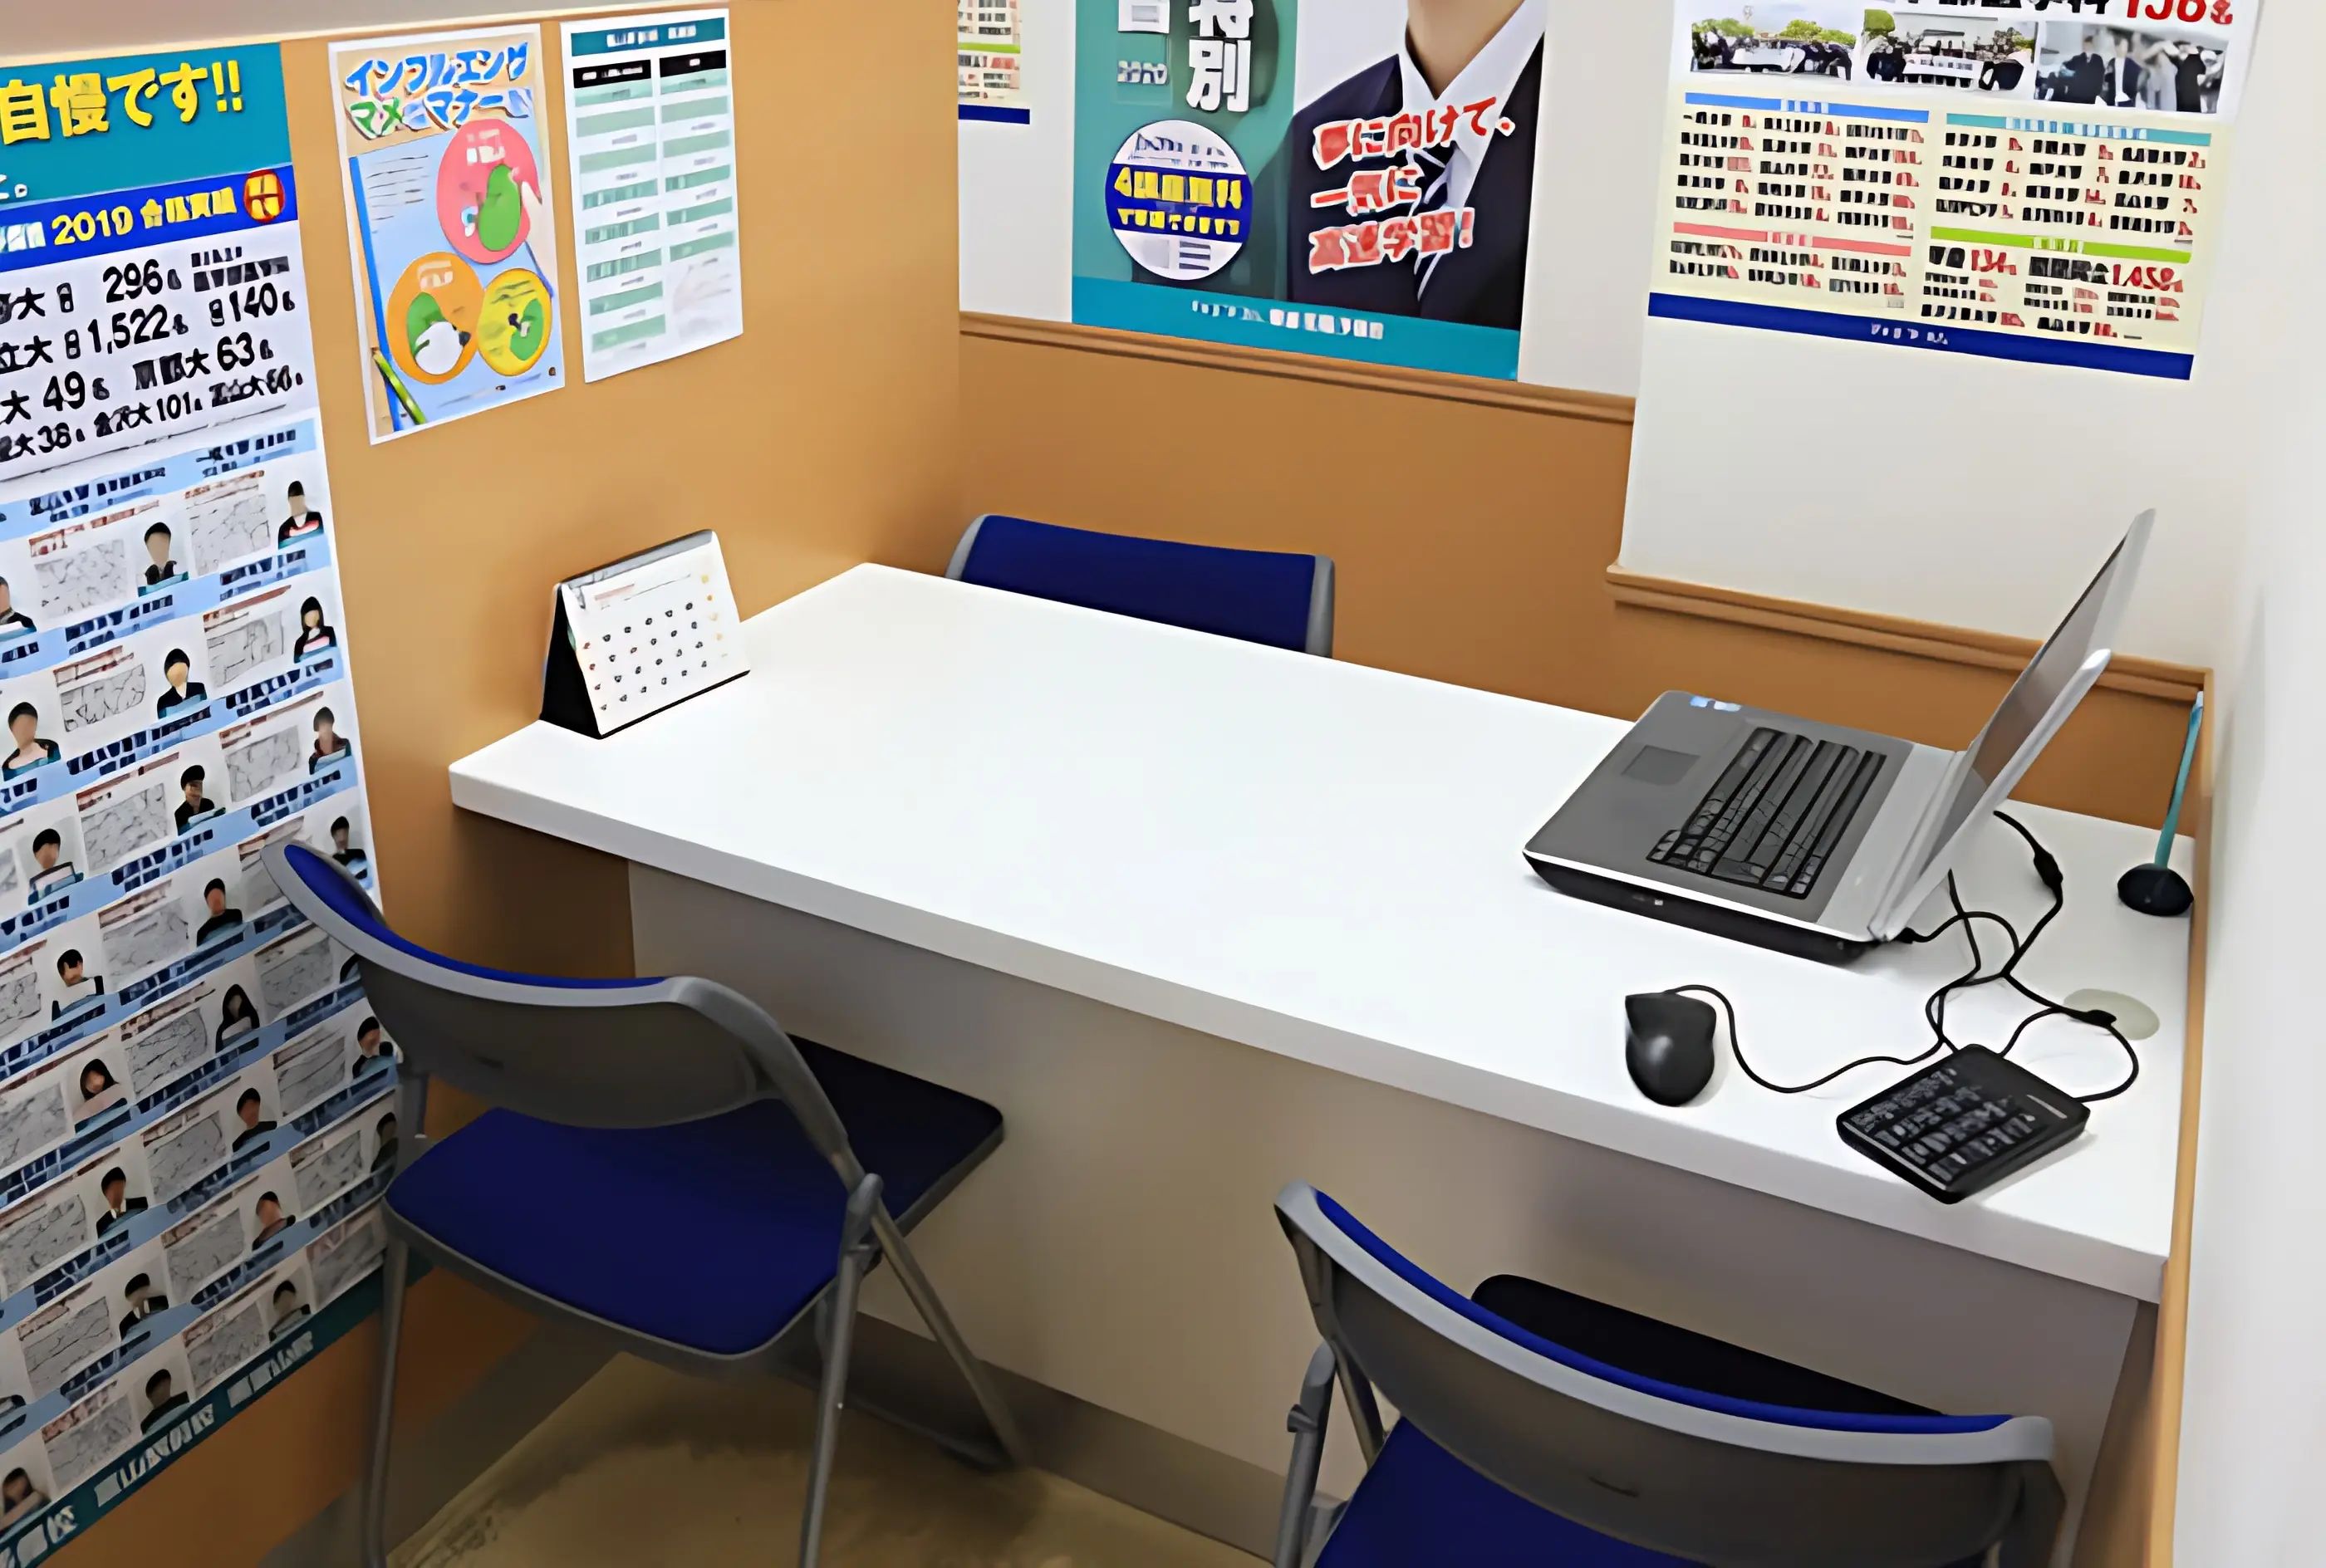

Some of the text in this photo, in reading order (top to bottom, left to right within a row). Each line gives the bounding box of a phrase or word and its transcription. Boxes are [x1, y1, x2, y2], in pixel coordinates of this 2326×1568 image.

[1313, 96, 1516, 171] に向けて、
[52, 206, 134, 246] 2019
